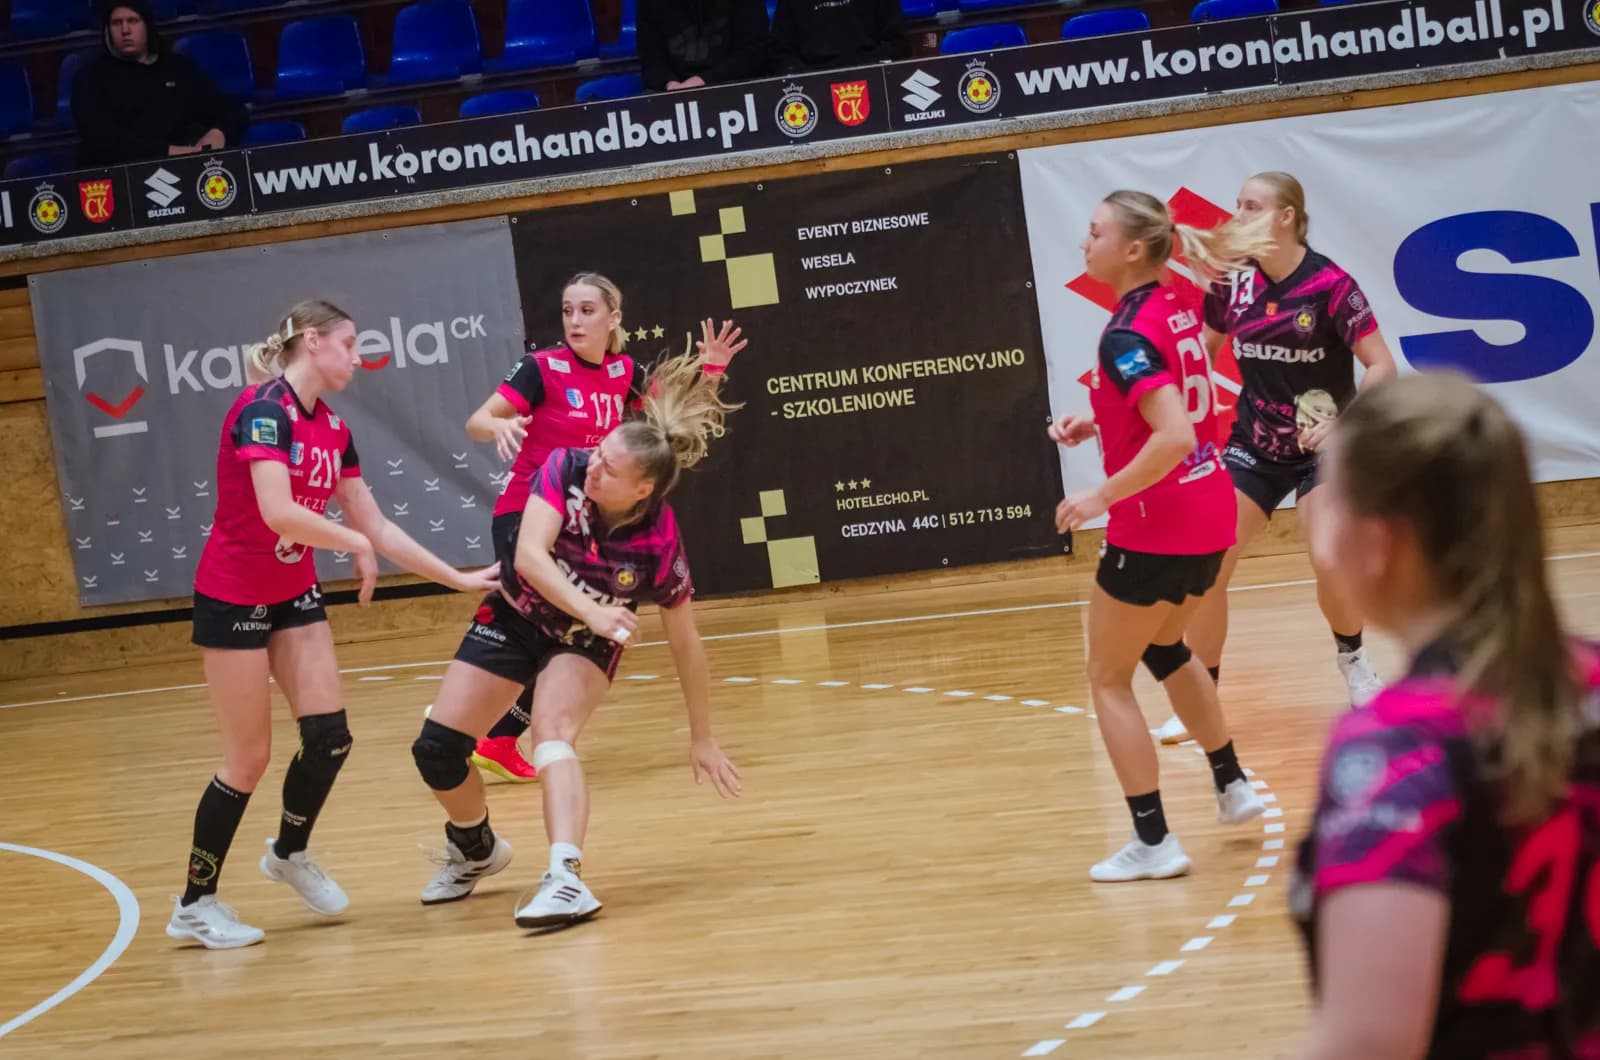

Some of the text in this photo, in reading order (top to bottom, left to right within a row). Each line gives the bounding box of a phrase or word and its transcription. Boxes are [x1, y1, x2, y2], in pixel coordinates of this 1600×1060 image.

[1015, 0, 1565, 96] www.koronahandball.pl
[836, 98, 864, 121] CK
[904, 109, 945, 122] SUZUKI
[254, 94, 758, 195] www.koronahandball.pl
[84, 196, 108, 219] CK
[147, 206, 185, 218] SUZUKI
[797, 212, 929, 240] EVENTY BIZNESOWE
[801, 252, 856, 270] WESELA
[805, 277, 898, 300] WYPOCZYNEK
[1242, 341, 1326, 363] SUZUKI
[766, 348, 1025, 395] CENTRUM KONFERENCYJNO
[783, 388, 916, 419] SZKOLENIOWE
[308, 446, 333, 489] 21
[836, 490, 930, 511] HOTELECHO.PL
[841, 519, 906, 538] CEDZYNA
[912, 515, 939, 530] 44C
[949, 511, 975, 526] 512
[977, 508, 1003, 523] 713
[1006, 504, 1032, 519] 594
